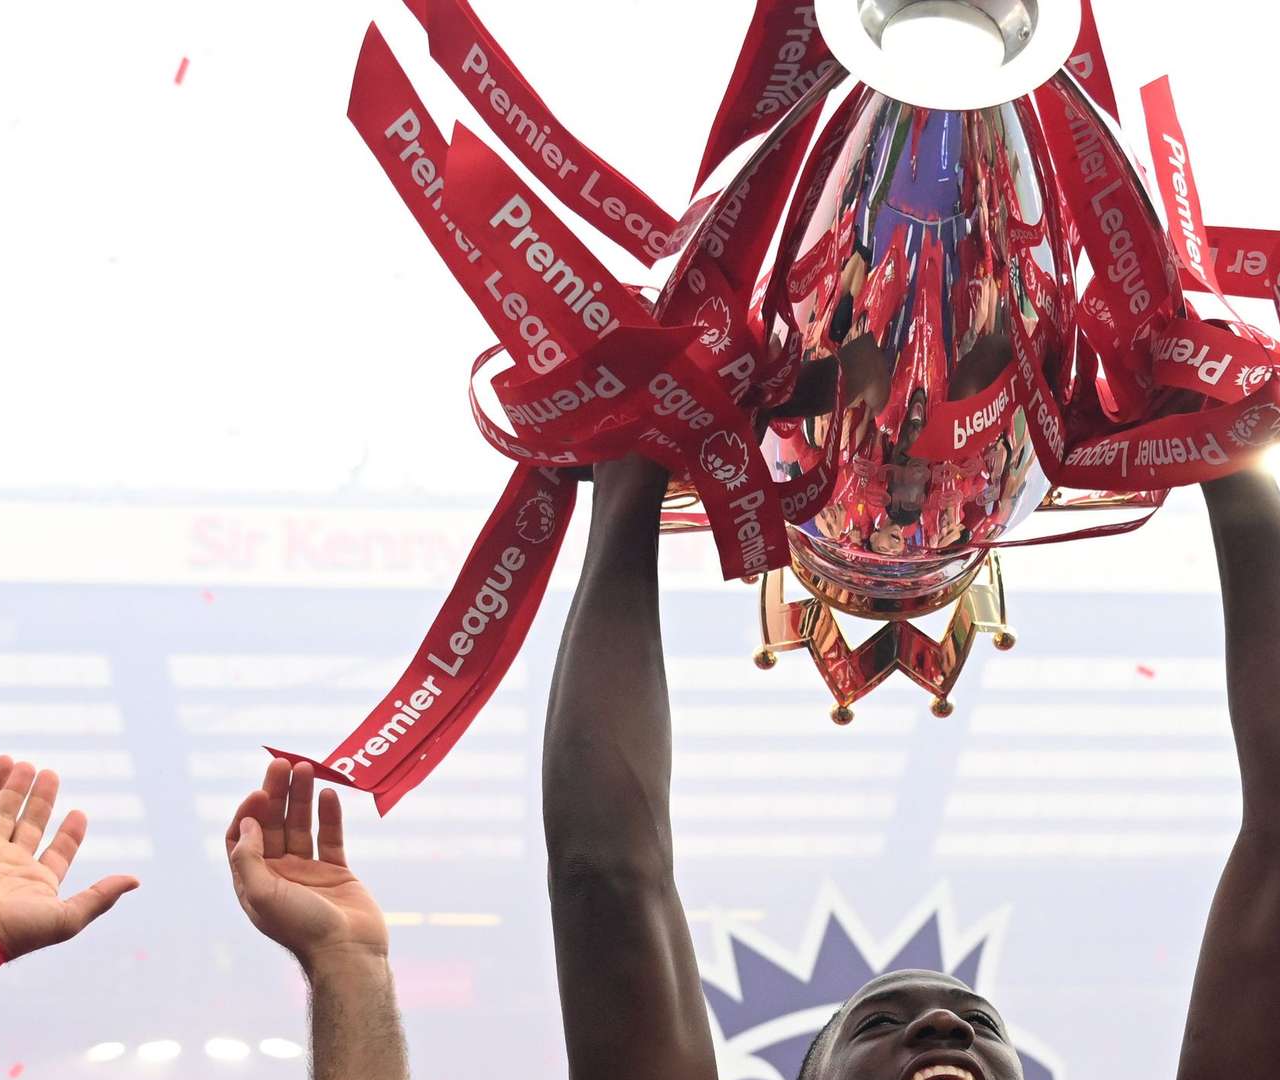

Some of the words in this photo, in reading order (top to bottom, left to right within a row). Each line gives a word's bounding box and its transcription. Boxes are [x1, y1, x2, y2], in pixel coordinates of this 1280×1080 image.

[461, 42, 579, 180] Premier
[579, 170, 673, 258] Leag
[1162, 133, 1208, 282] Premier
[1090, 179, 1151, 315] League
[484, 270, 567, 375] Leag
[648, 373, 715, 430] ague
[1065, 438, 1129, 477] League
[1134, 432, 1230, 476] Premier
[329, 675, 443, 782] Premier
[427, 546, 526, 677] League
